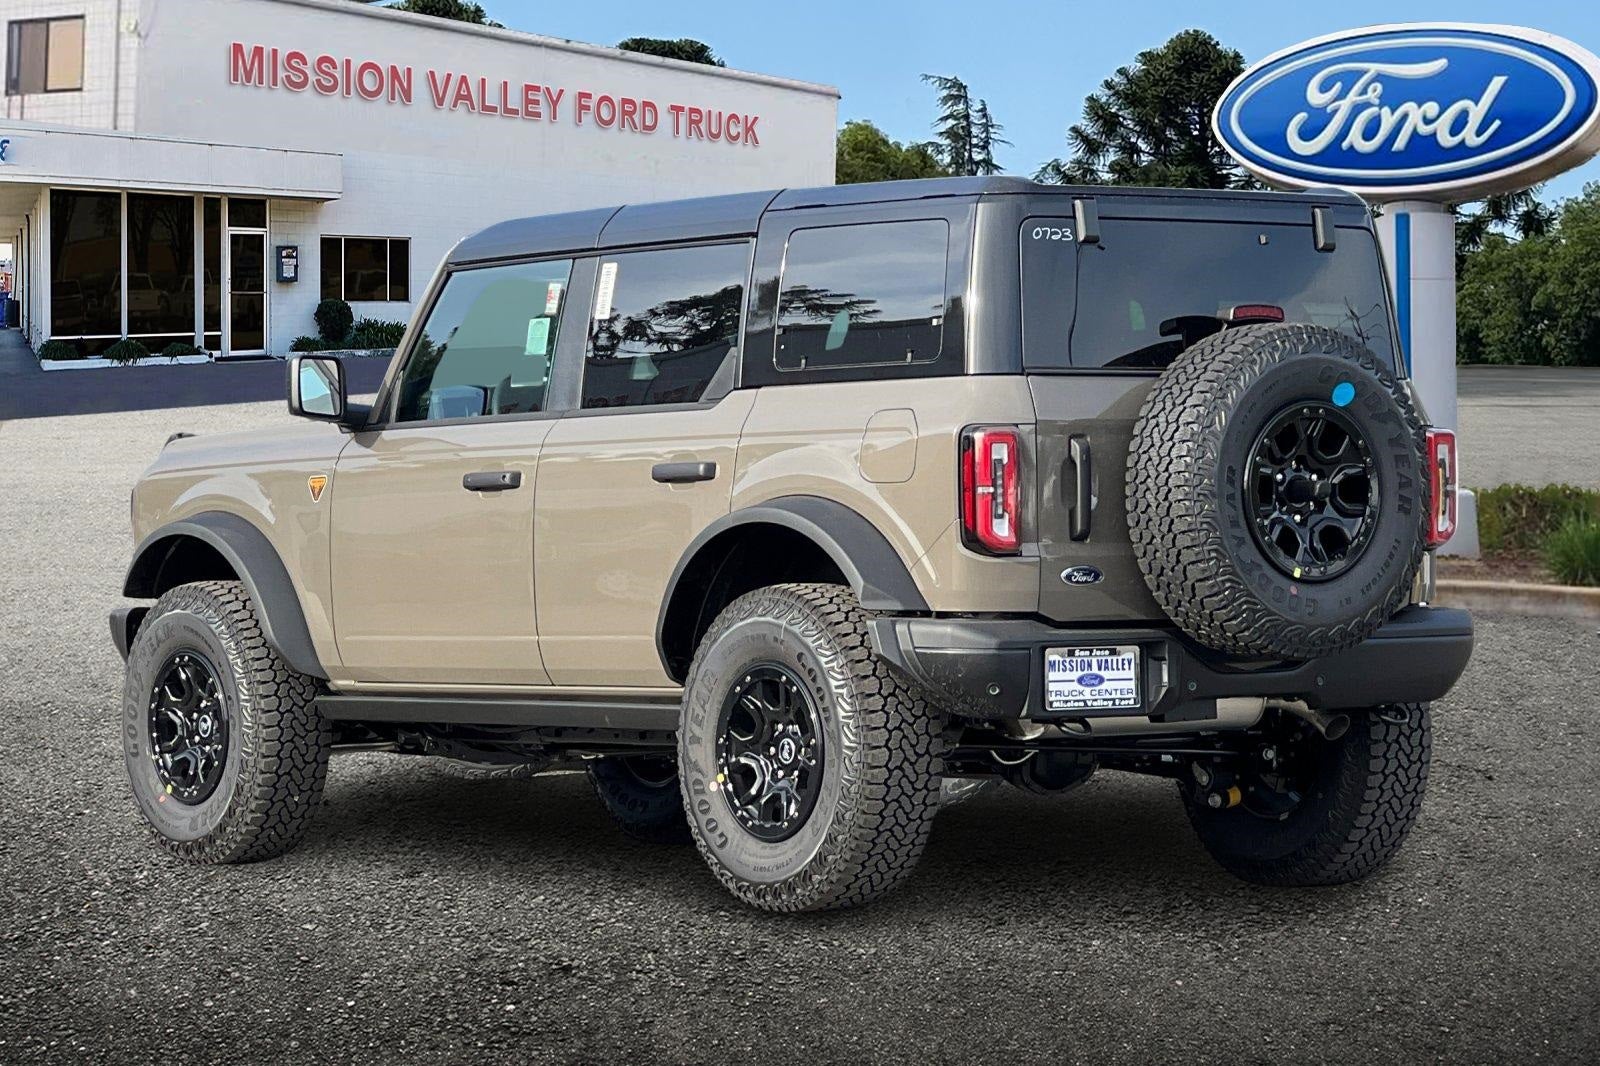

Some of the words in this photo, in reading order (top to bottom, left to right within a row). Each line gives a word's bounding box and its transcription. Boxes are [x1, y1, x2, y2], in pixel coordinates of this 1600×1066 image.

[229, 41, 413, 105] MISSION
[428, 69, 565, 122] VALLEY
[576, 90, 659, 133] FORD
[669, 103, 760, 146] TRUCK
[1286, 57, 1509, 156] Ford
[1032, 226, 1074, 241] 0723
[1071, 570, 1095, 582] Ford
[1048, 658, 1093, 672] MISSION
[1097, 657, 1133, 672] VALLEY
[1081, 675, 1100, 685] Ford
[1048, 689, 1085, 698] TRUCK
[1089, 688, 1134, 697] CENTER
[1052, 699, 1084, 708] Mission
[1086, 699, 1113, 708] Valley
